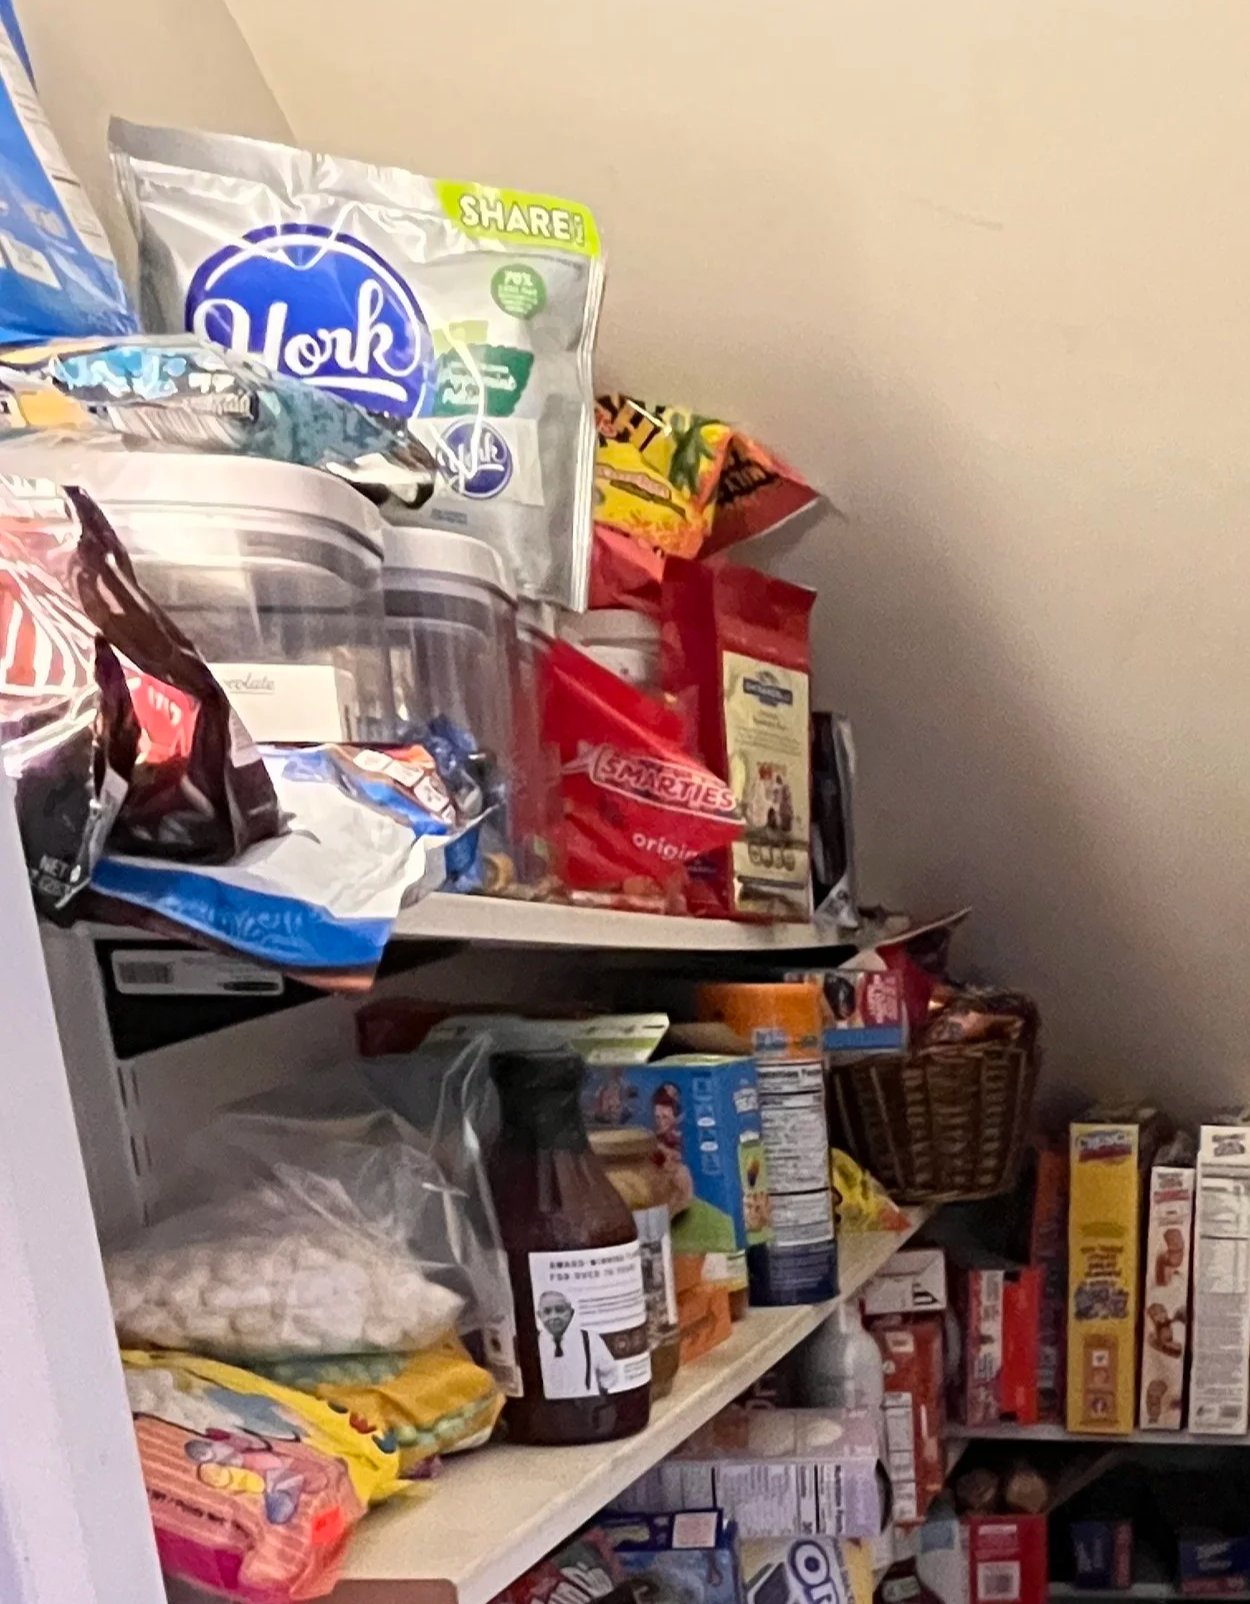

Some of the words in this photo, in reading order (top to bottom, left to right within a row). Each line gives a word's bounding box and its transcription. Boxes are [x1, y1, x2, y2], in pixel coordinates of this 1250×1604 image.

[458, 193, 573, 242] SHARE
[193, 279, 420, 376] York
[600, 756, 738, 813] SMARTIES
